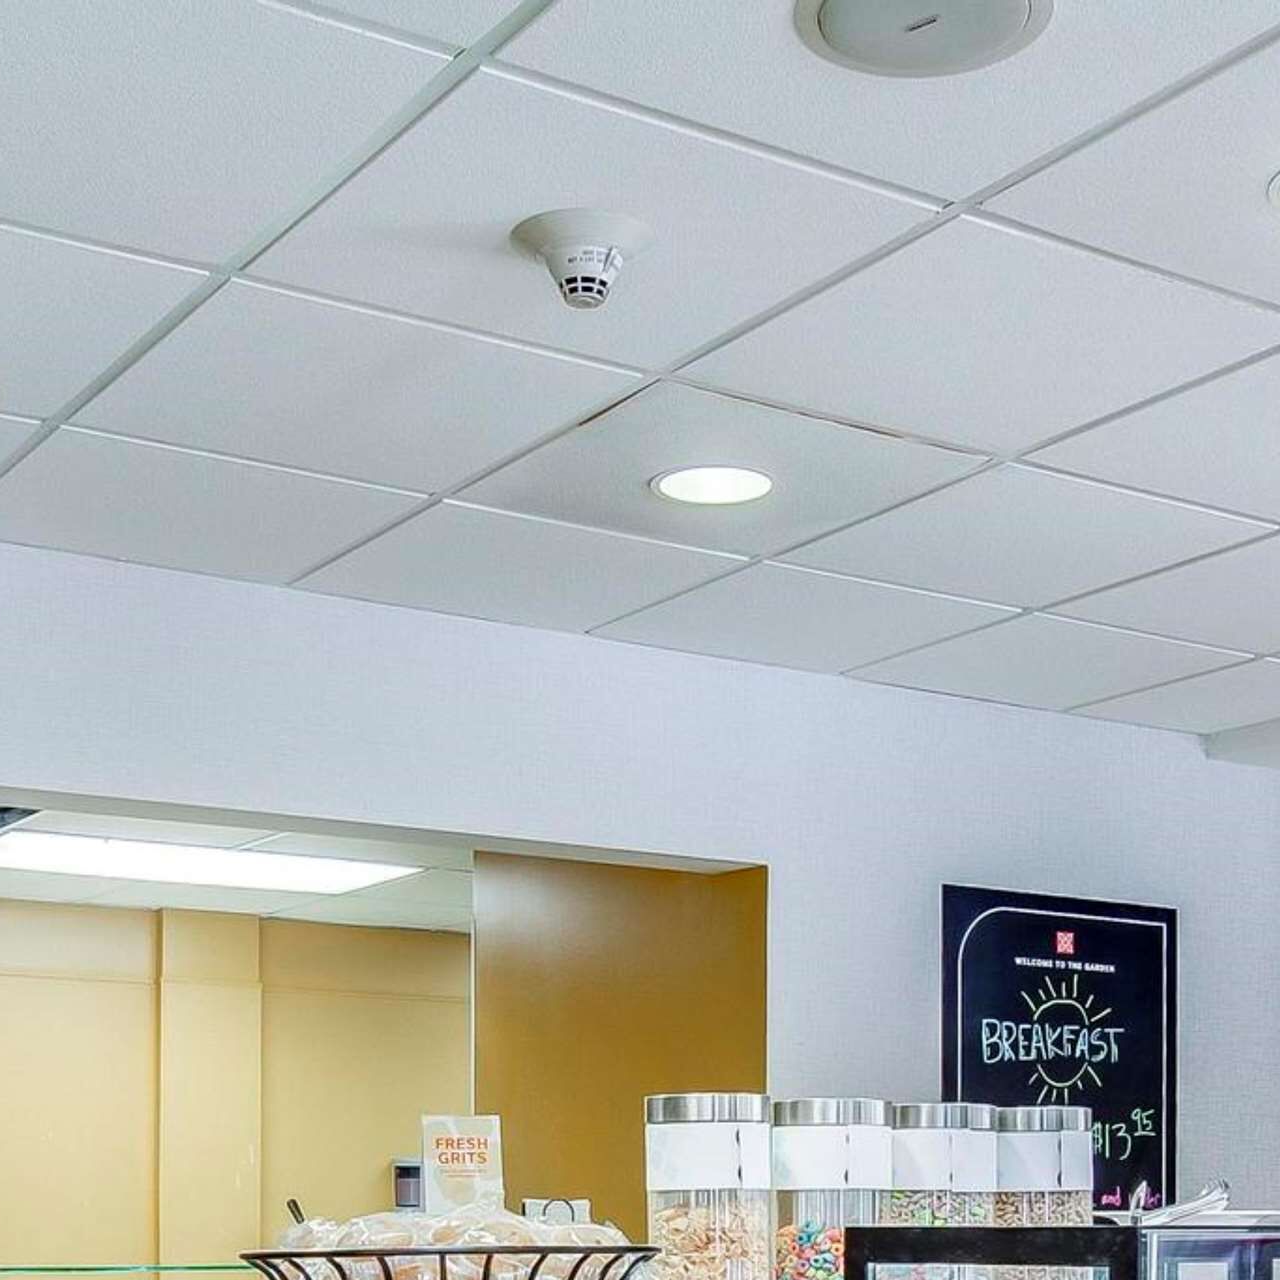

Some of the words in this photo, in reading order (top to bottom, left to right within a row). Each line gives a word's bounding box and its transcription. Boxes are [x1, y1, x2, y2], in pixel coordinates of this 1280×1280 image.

[1014, 957, 1053, 968] WELCOME
[1055, 960, 1066, 969] TO
[1068, 961, 1082, 970] THE
[1084, 963, 1115, 973] GARDEN
[982, 1018, 1125, 1064] BREAKFAST
[435, 1137, 489, 1149] FRESH
[438, 1151, 488, 1165] GRITS
